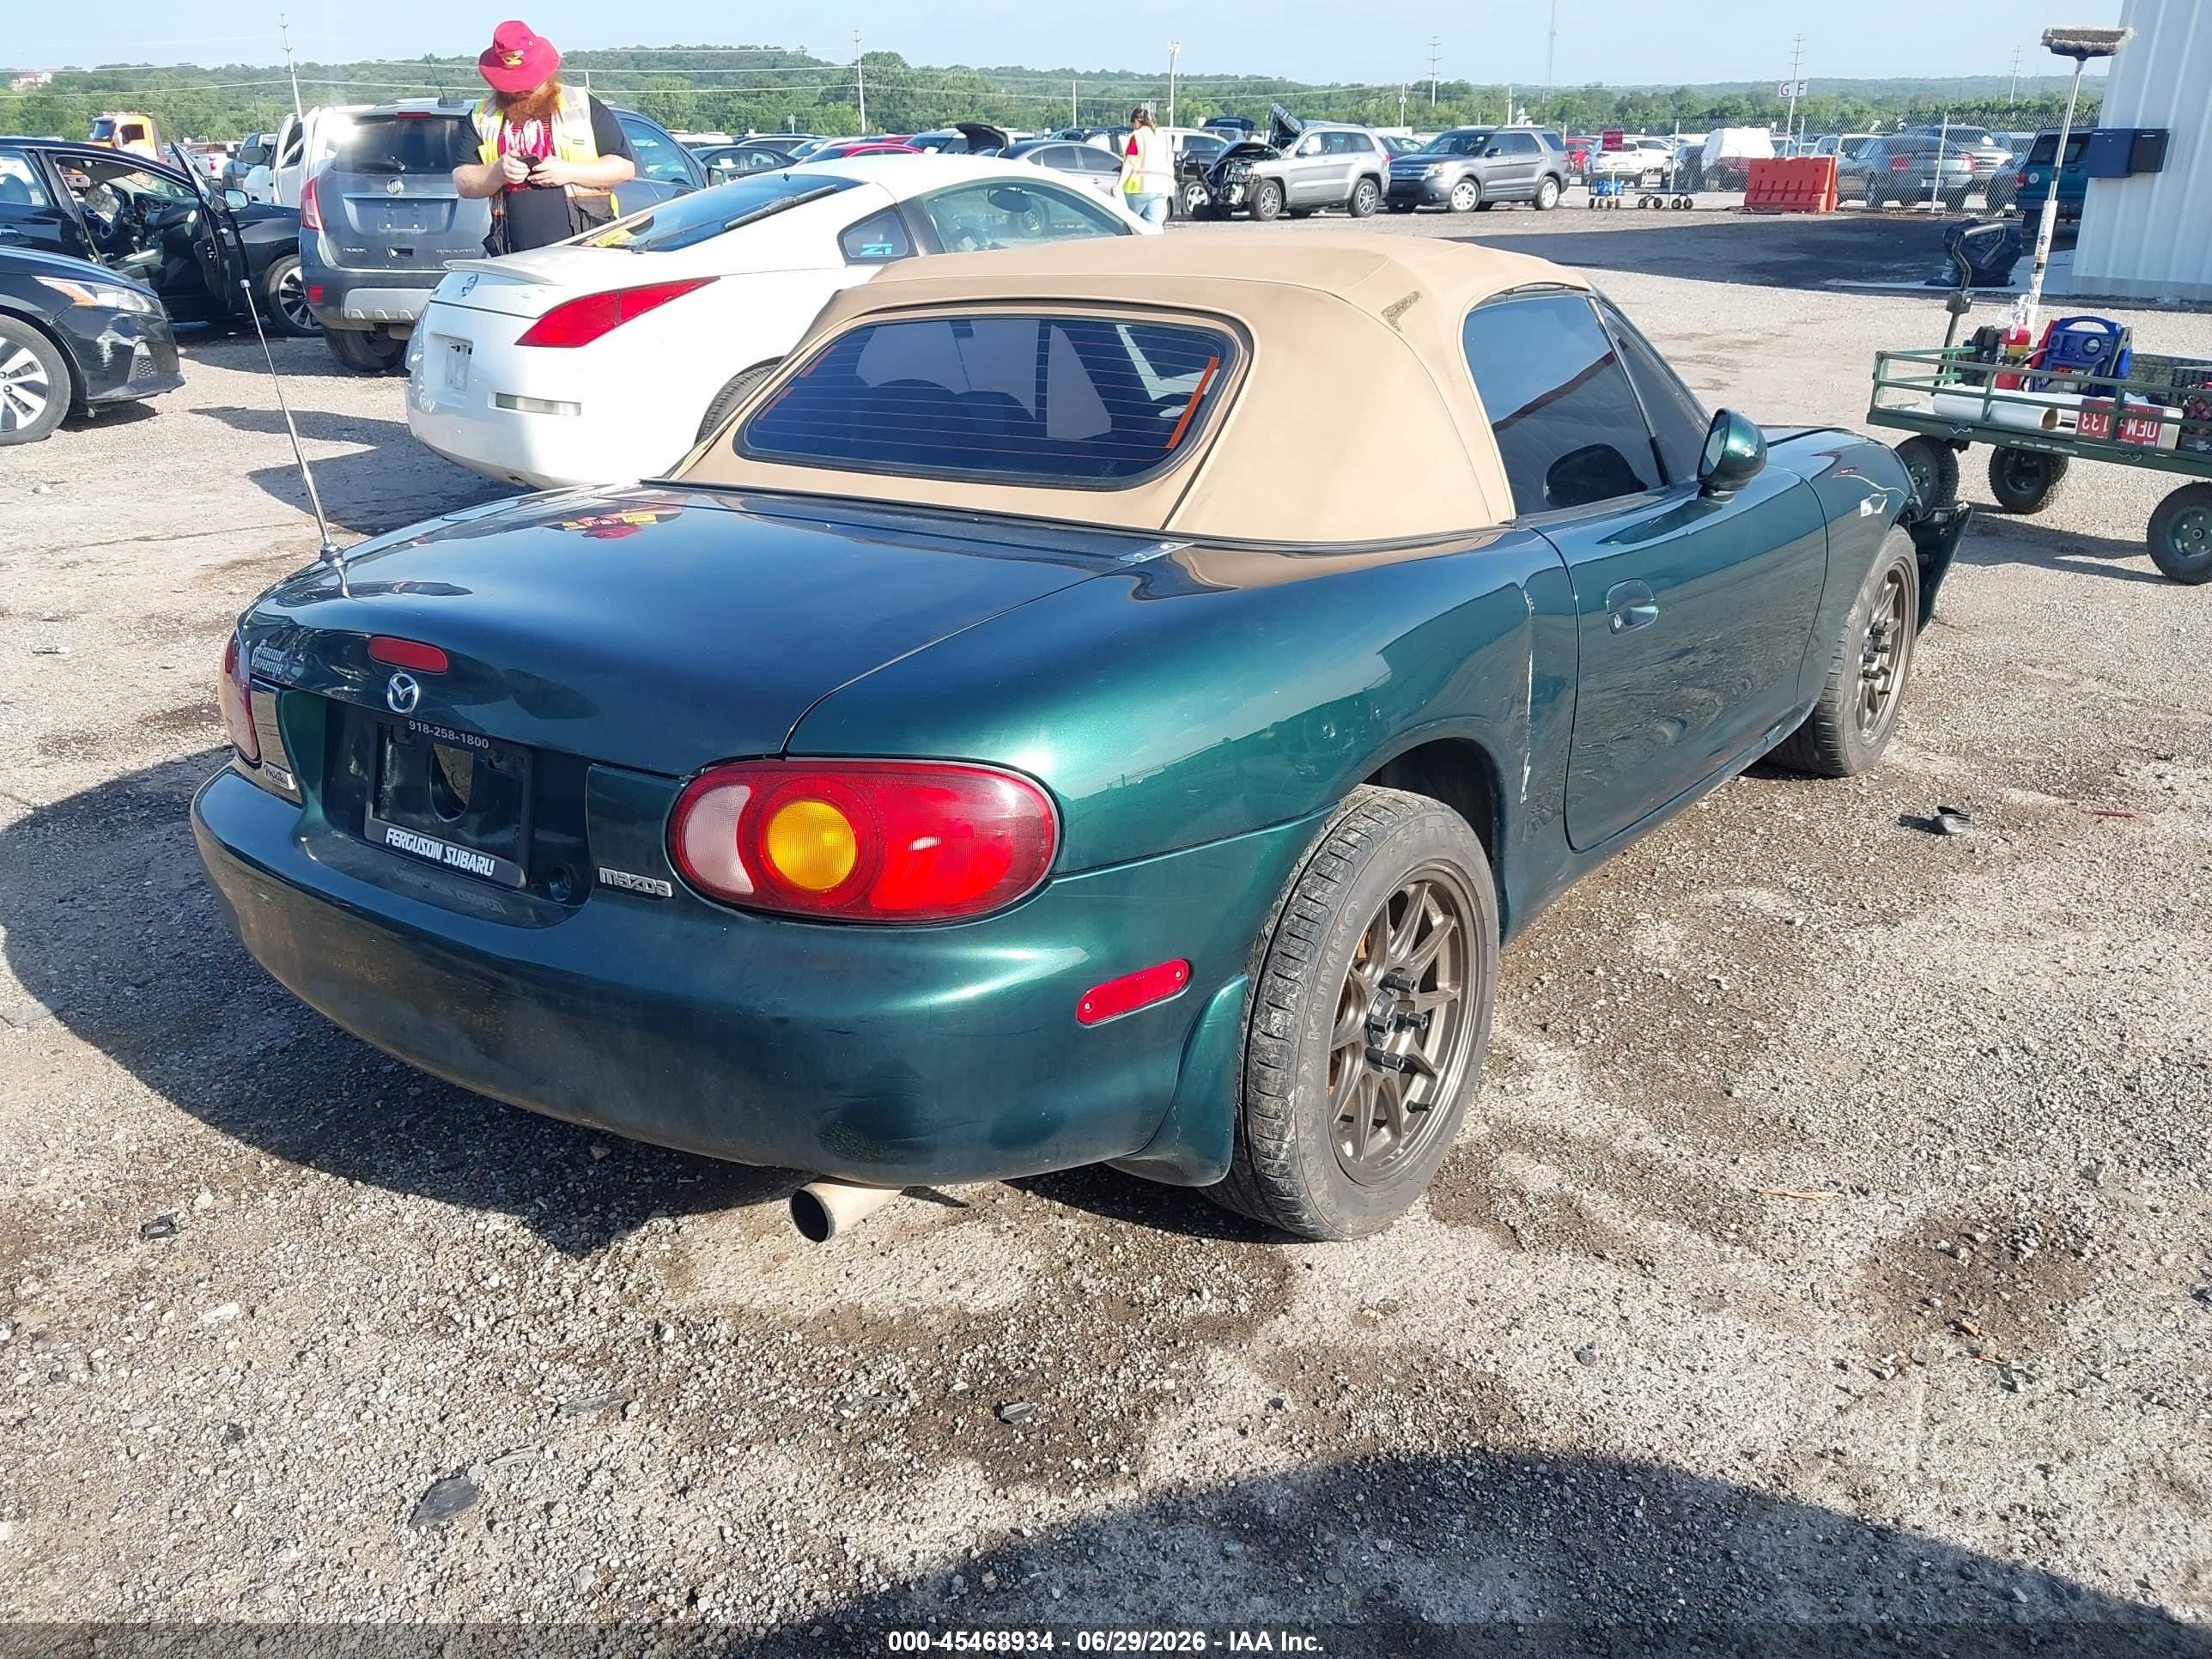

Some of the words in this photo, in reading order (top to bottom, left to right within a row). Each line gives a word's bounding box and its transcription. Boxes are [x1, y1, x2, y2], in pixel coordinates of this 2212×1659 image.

[1780, 82, 1790, 96] G
[1796, 82, 1805, 96] F
[408, 720, 489, 749] 918-258-1800
[386, 827, 444, 860] FERGUSON
[443, 846, 495, 877] SUBARU
